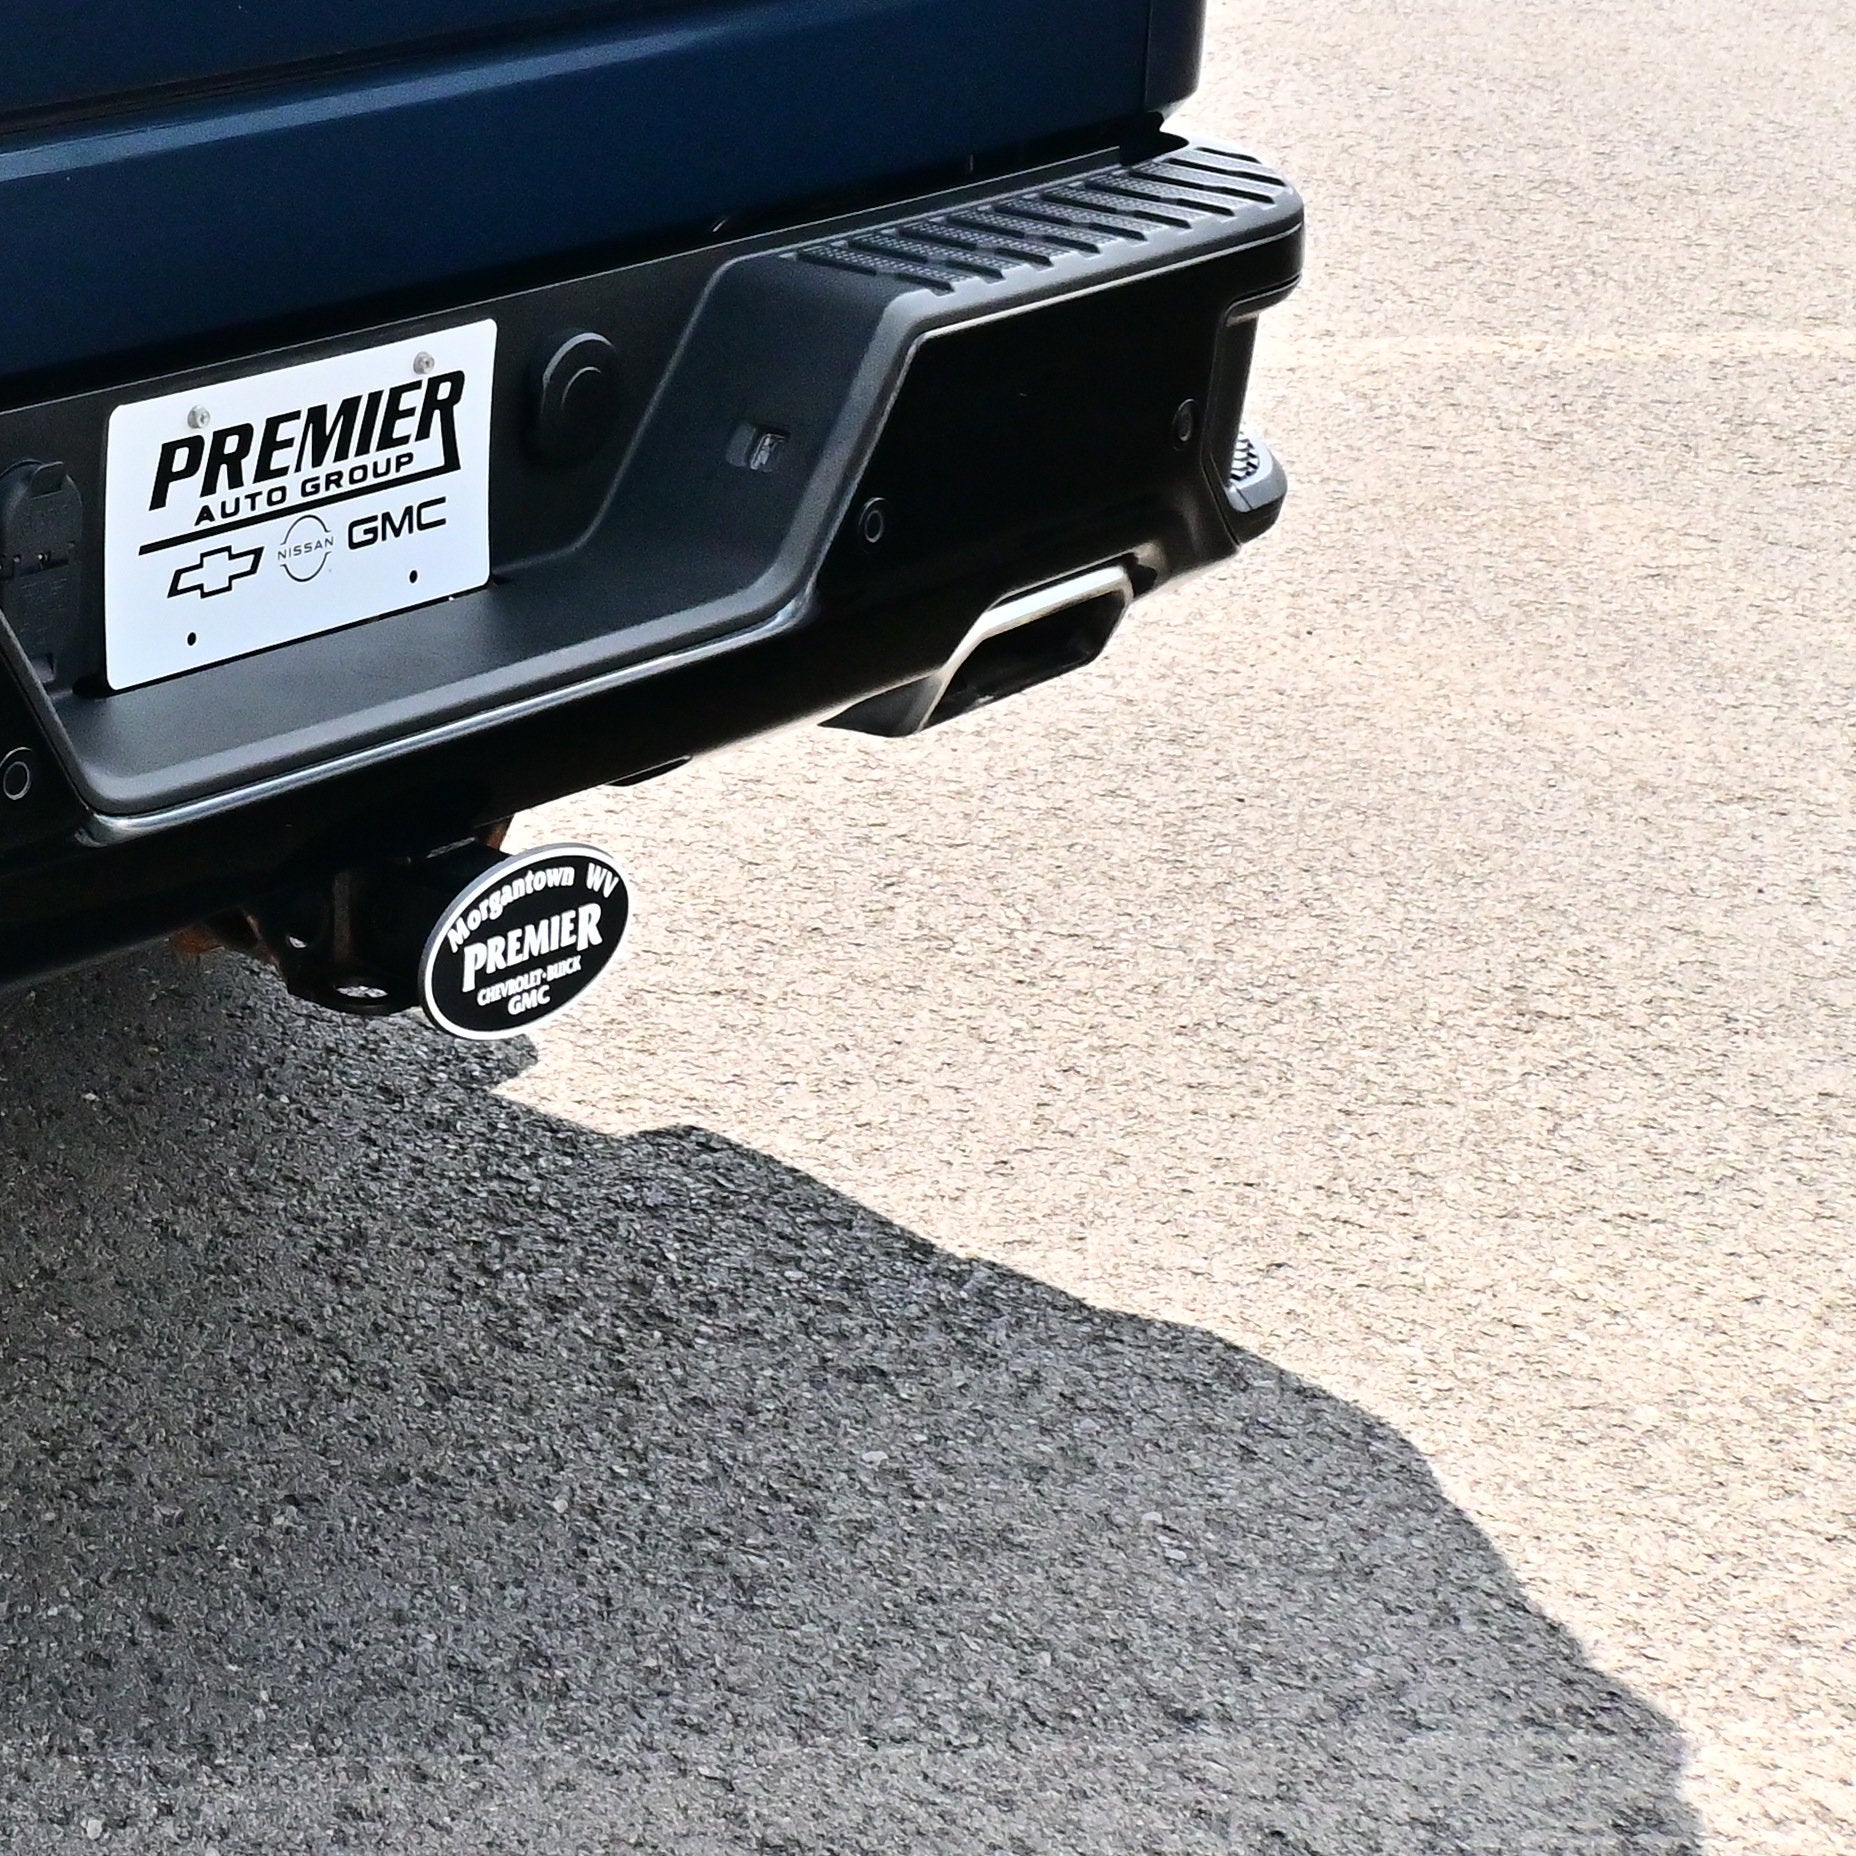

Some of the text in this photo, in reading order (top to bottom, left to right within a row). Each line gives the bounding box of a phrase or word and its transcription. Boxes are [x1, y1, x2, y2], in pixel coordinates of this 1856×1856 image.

[149, 370, 465, 511] PREMIER
[194, 452, 414, 526] AUTO GROUP
[277, 496, 447, 561] NISSAN GMC
[446, 862, 619, 953] Morgantown WV
[462, 902, 603, 993] PREMIER
[476, 955, 582, 1006] CHEVROLET BUICK
[507, 985, 550, 1016] GMC
